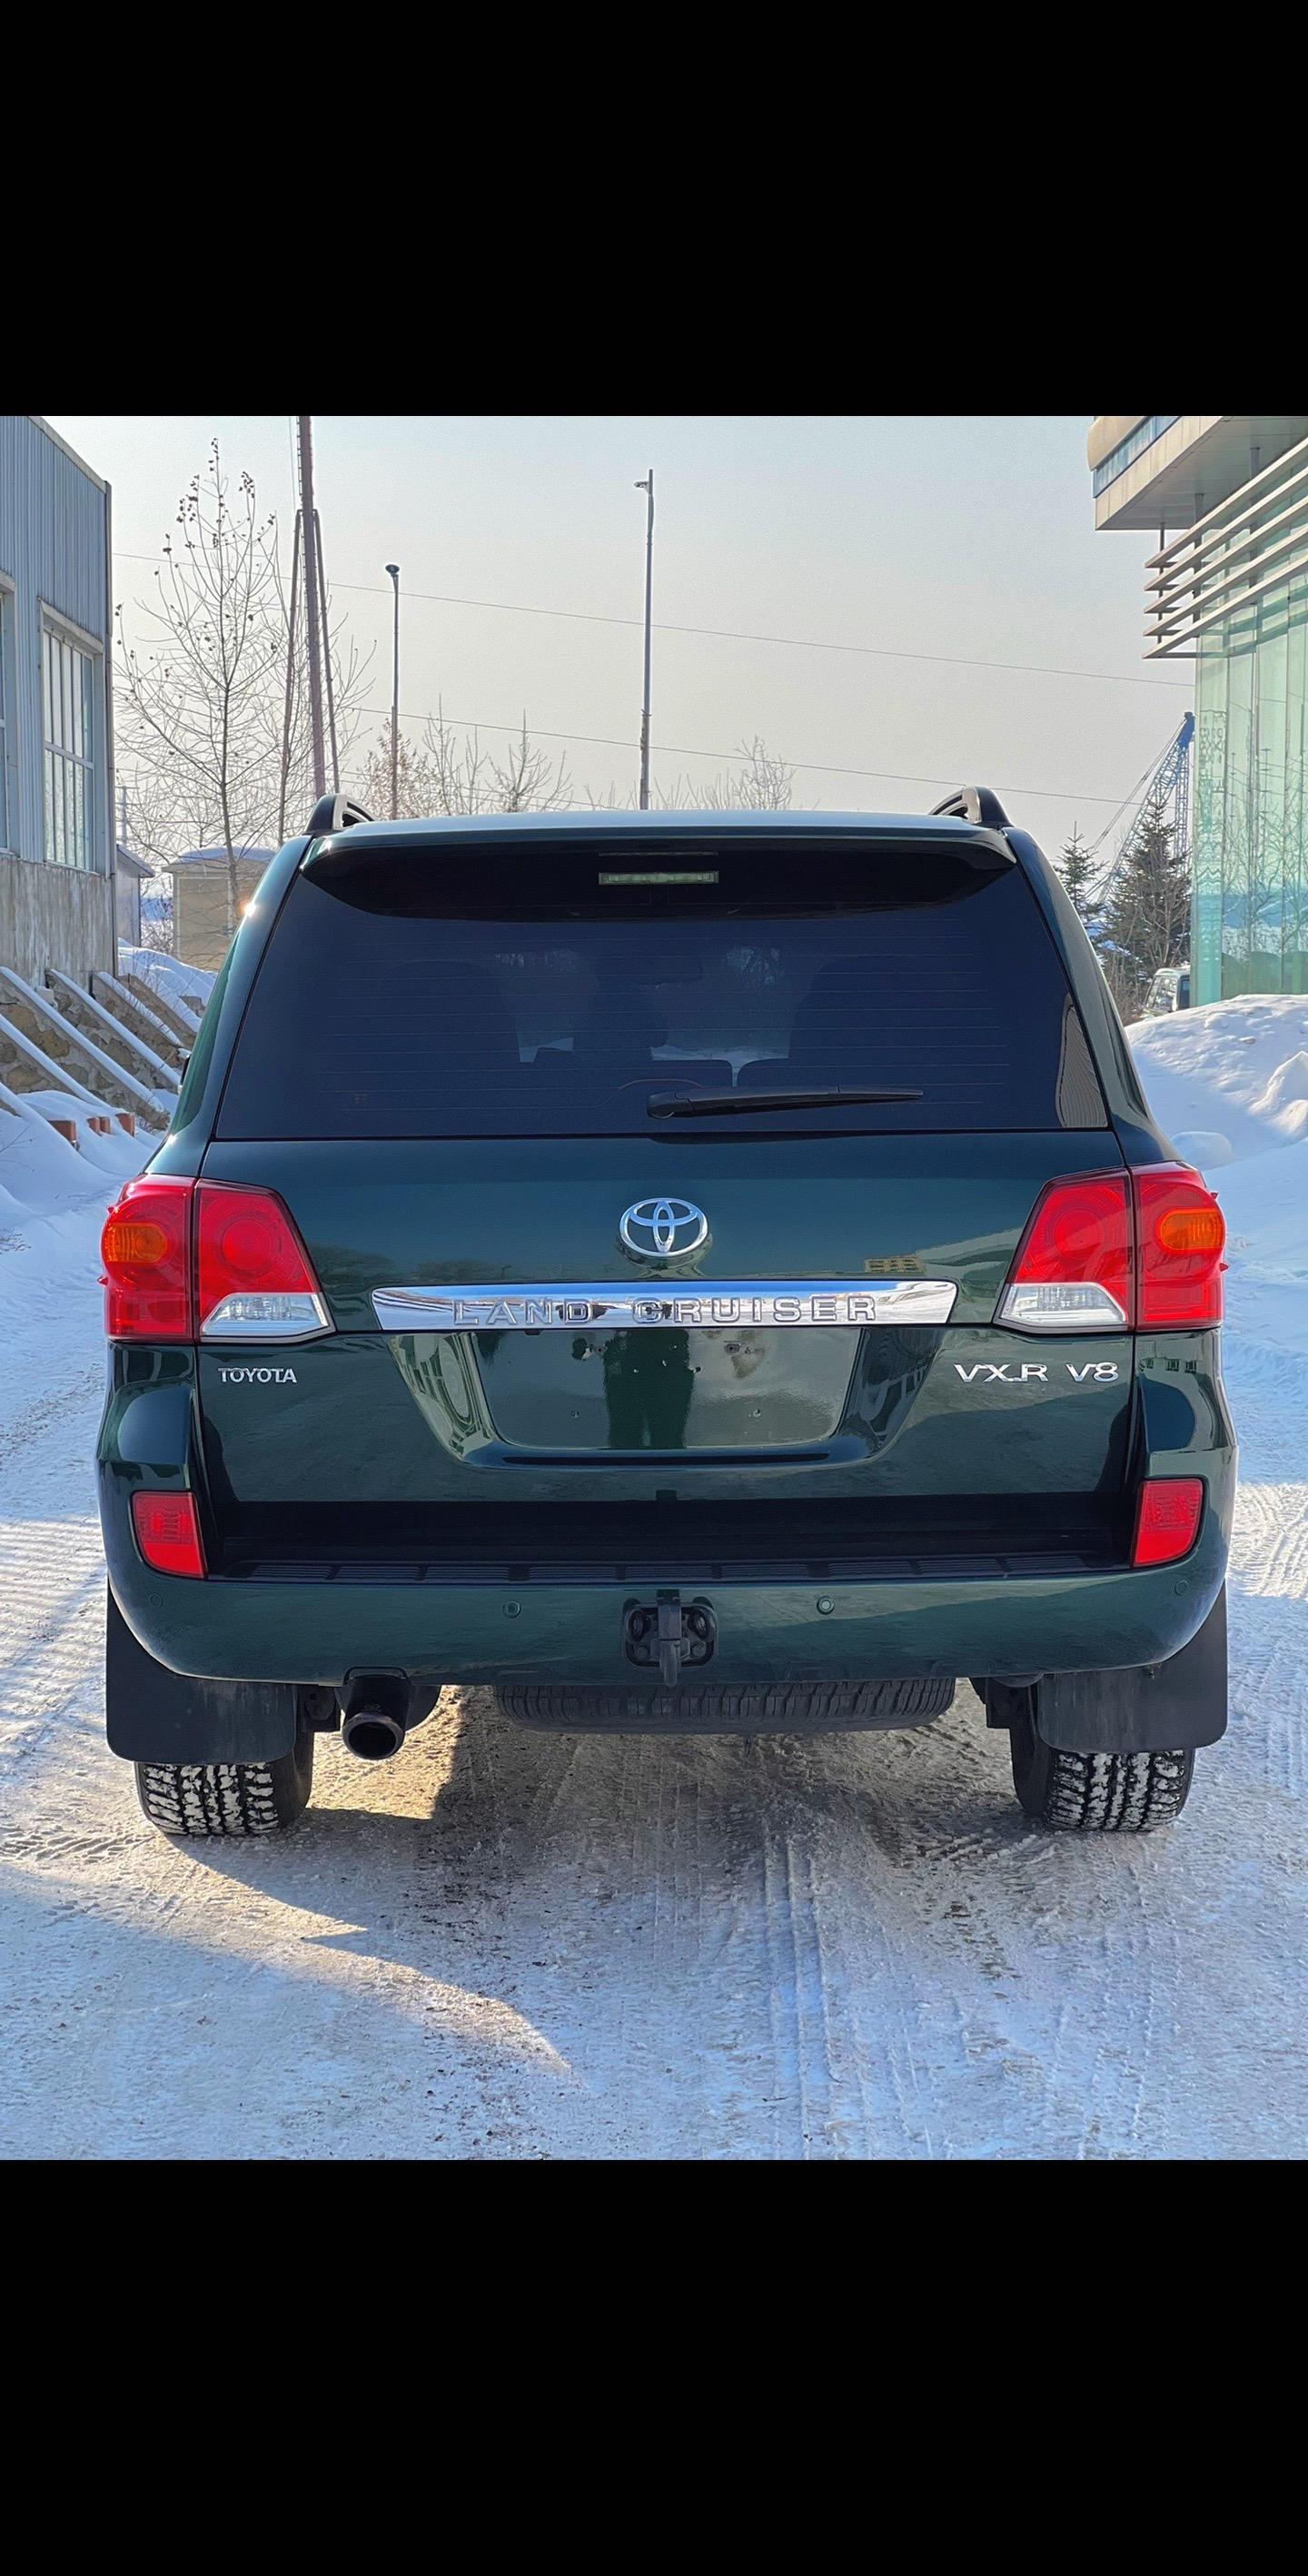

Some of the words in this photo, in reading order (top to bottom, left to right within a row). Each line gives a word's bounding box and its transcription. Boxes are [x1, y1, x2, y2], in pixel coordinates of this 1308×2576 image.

[453, 1297, 591, 1325] LAND
[632, 1295, 877, 1323] CRUISER
[218, 1367, 297, 1383] TOYOTA
[1065, 1362, 1119, 1382] V8
